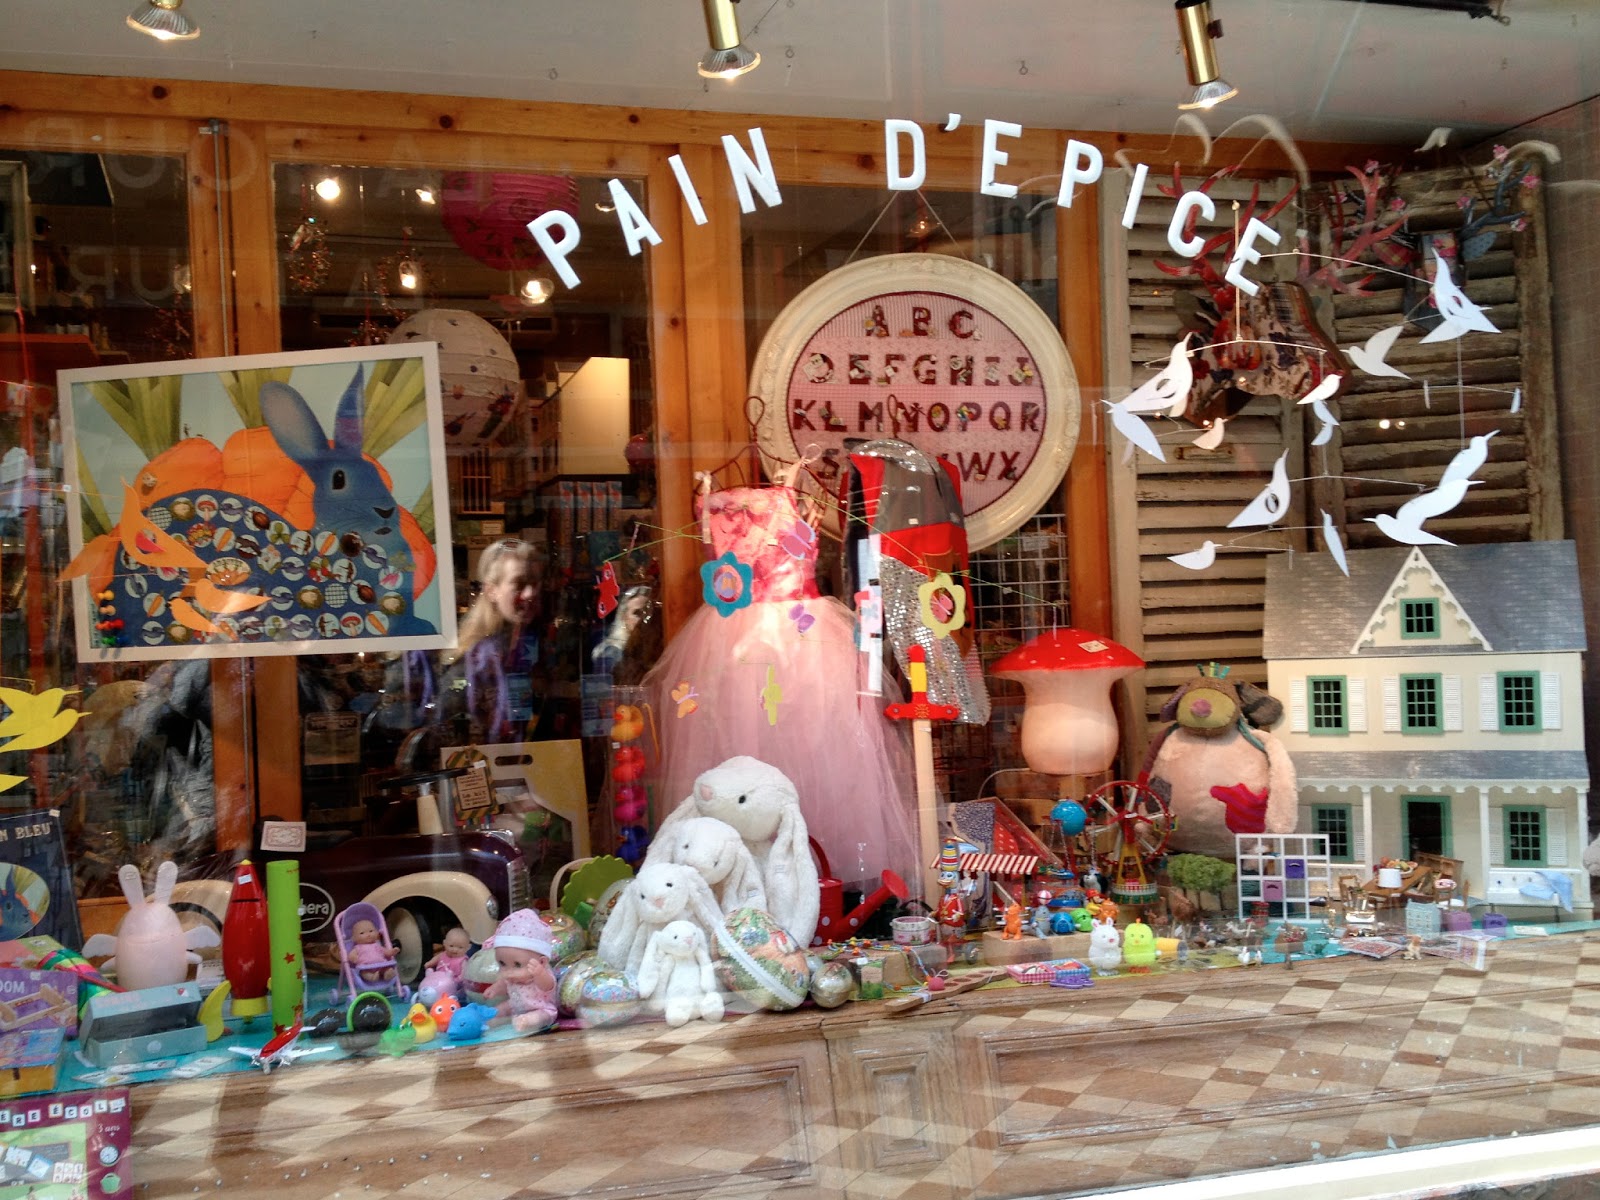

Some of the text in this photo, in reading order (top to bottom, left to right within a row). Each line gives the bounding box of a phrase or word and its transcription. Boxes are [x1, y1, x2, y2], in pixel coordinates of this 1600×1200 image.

[527, 113, 1281, 296] PAIN D'EPICE
[15, 822, 51, 839] BLEU
[51, 1102, 121, 1117] ÉCOL
